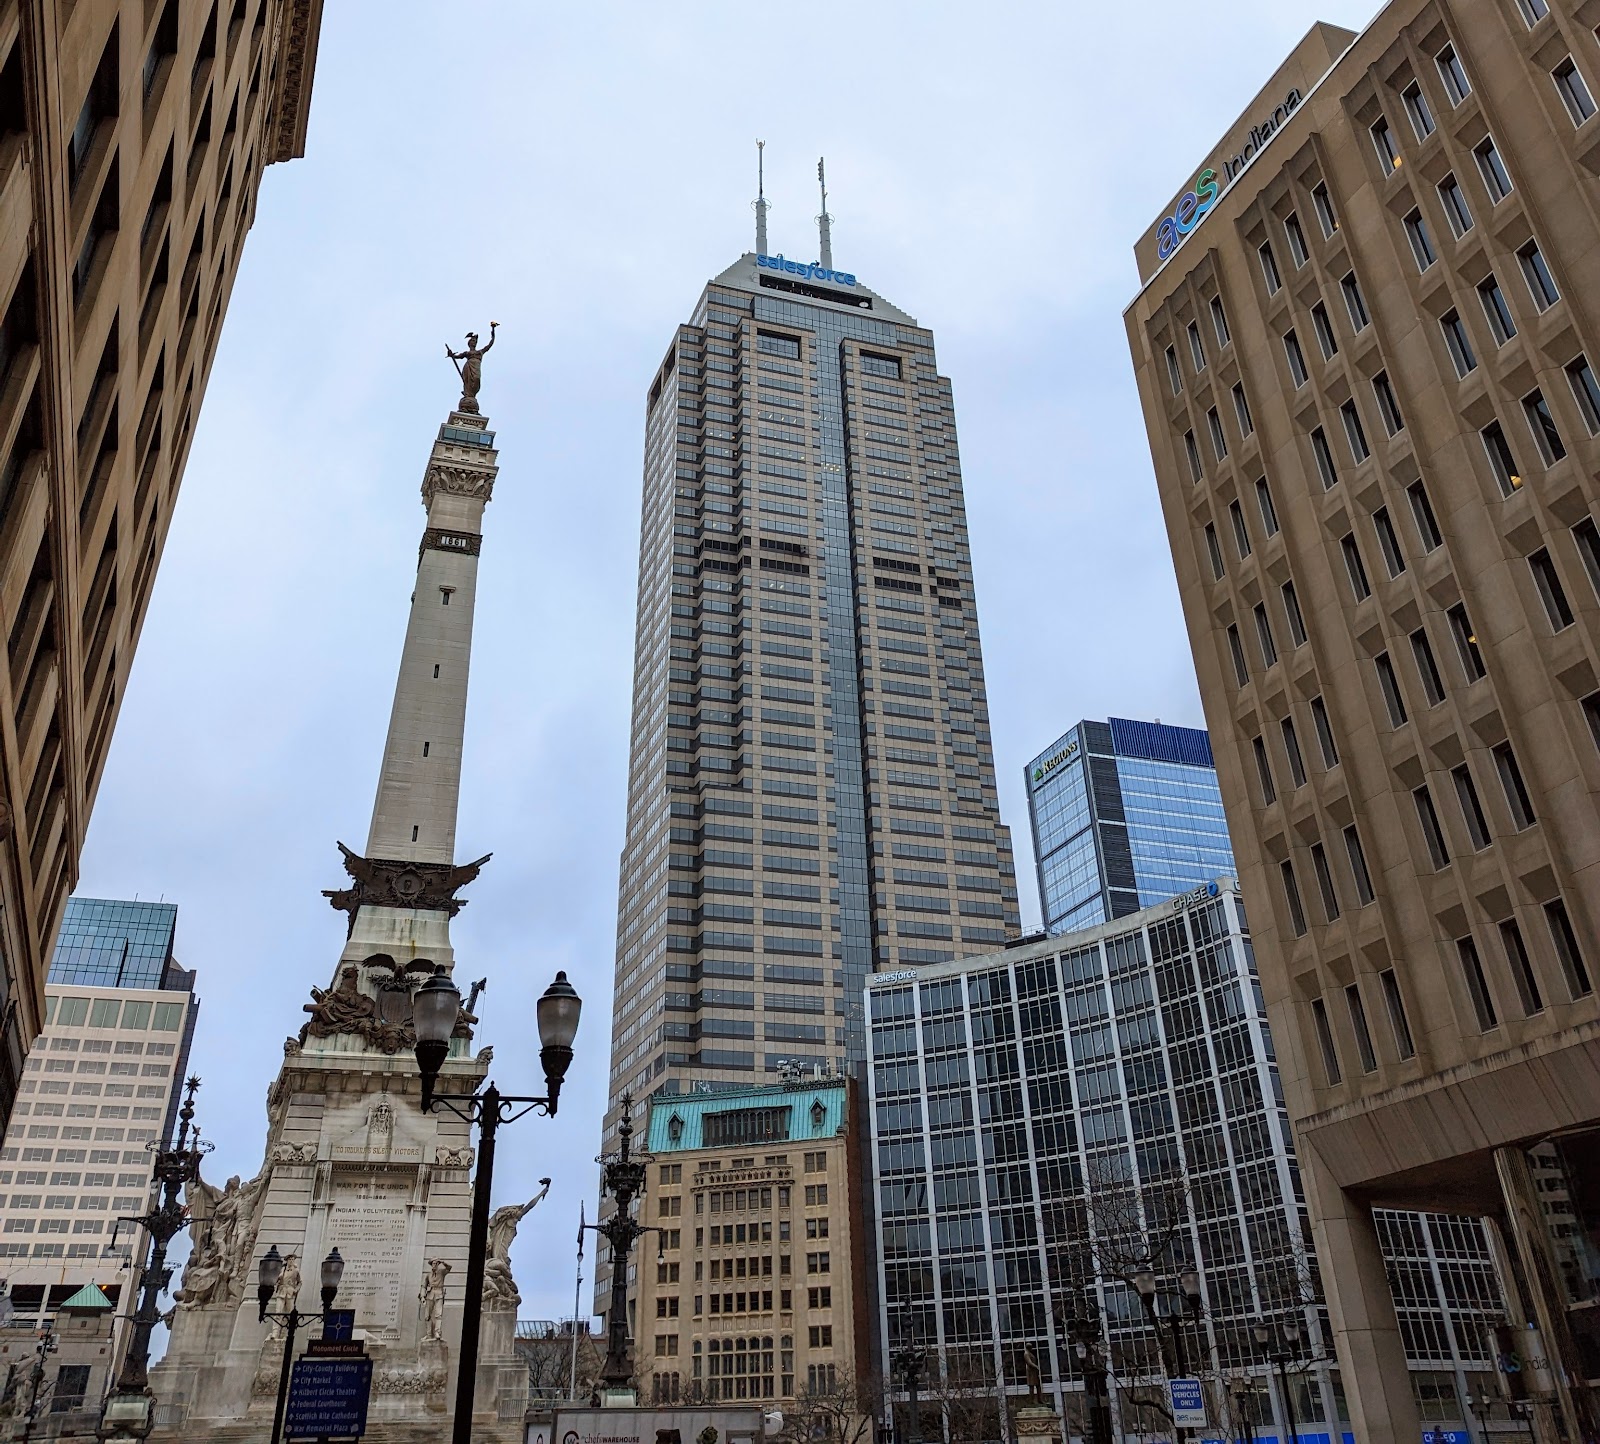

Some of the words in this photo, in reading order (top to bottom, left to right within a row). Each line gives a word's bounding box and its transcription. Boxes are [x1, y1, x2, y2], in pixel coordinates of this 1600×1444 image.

[1155, 168, 1220, 261] aes
[1222, 88, 1302, 186] Indiana
[756, 254, 856, 286] salesforce
[1042, 741, 1078, 774] REGIONS
[1172, 886, 1208, 911] CHASE
[873, 970, 917, 983] salesforce
[312, 1344, 341, 1353] Monument
[342, 1344, 359, 1352] Circle
[302, 1364, 334, 1373] City-County
[335, 1364, 358, 1373] Building
[300, 1376, 311, 1385] City
[312, 1376, 331, 1384] Market
[296, 1400, 317, 1408] Federal
[317, 1400, 347, 1408] Courthouse
[295, 1412, 318, 1420] Scottish
[319, 1412, 330, 1420] Rite
[331, 1411, 358, 1420] Cathedral
[1176, 1414, 1189, 1422] aes
[306, 1424, 332, 1432] Memorial
[332, 1424, 348, 1432] Plaza
